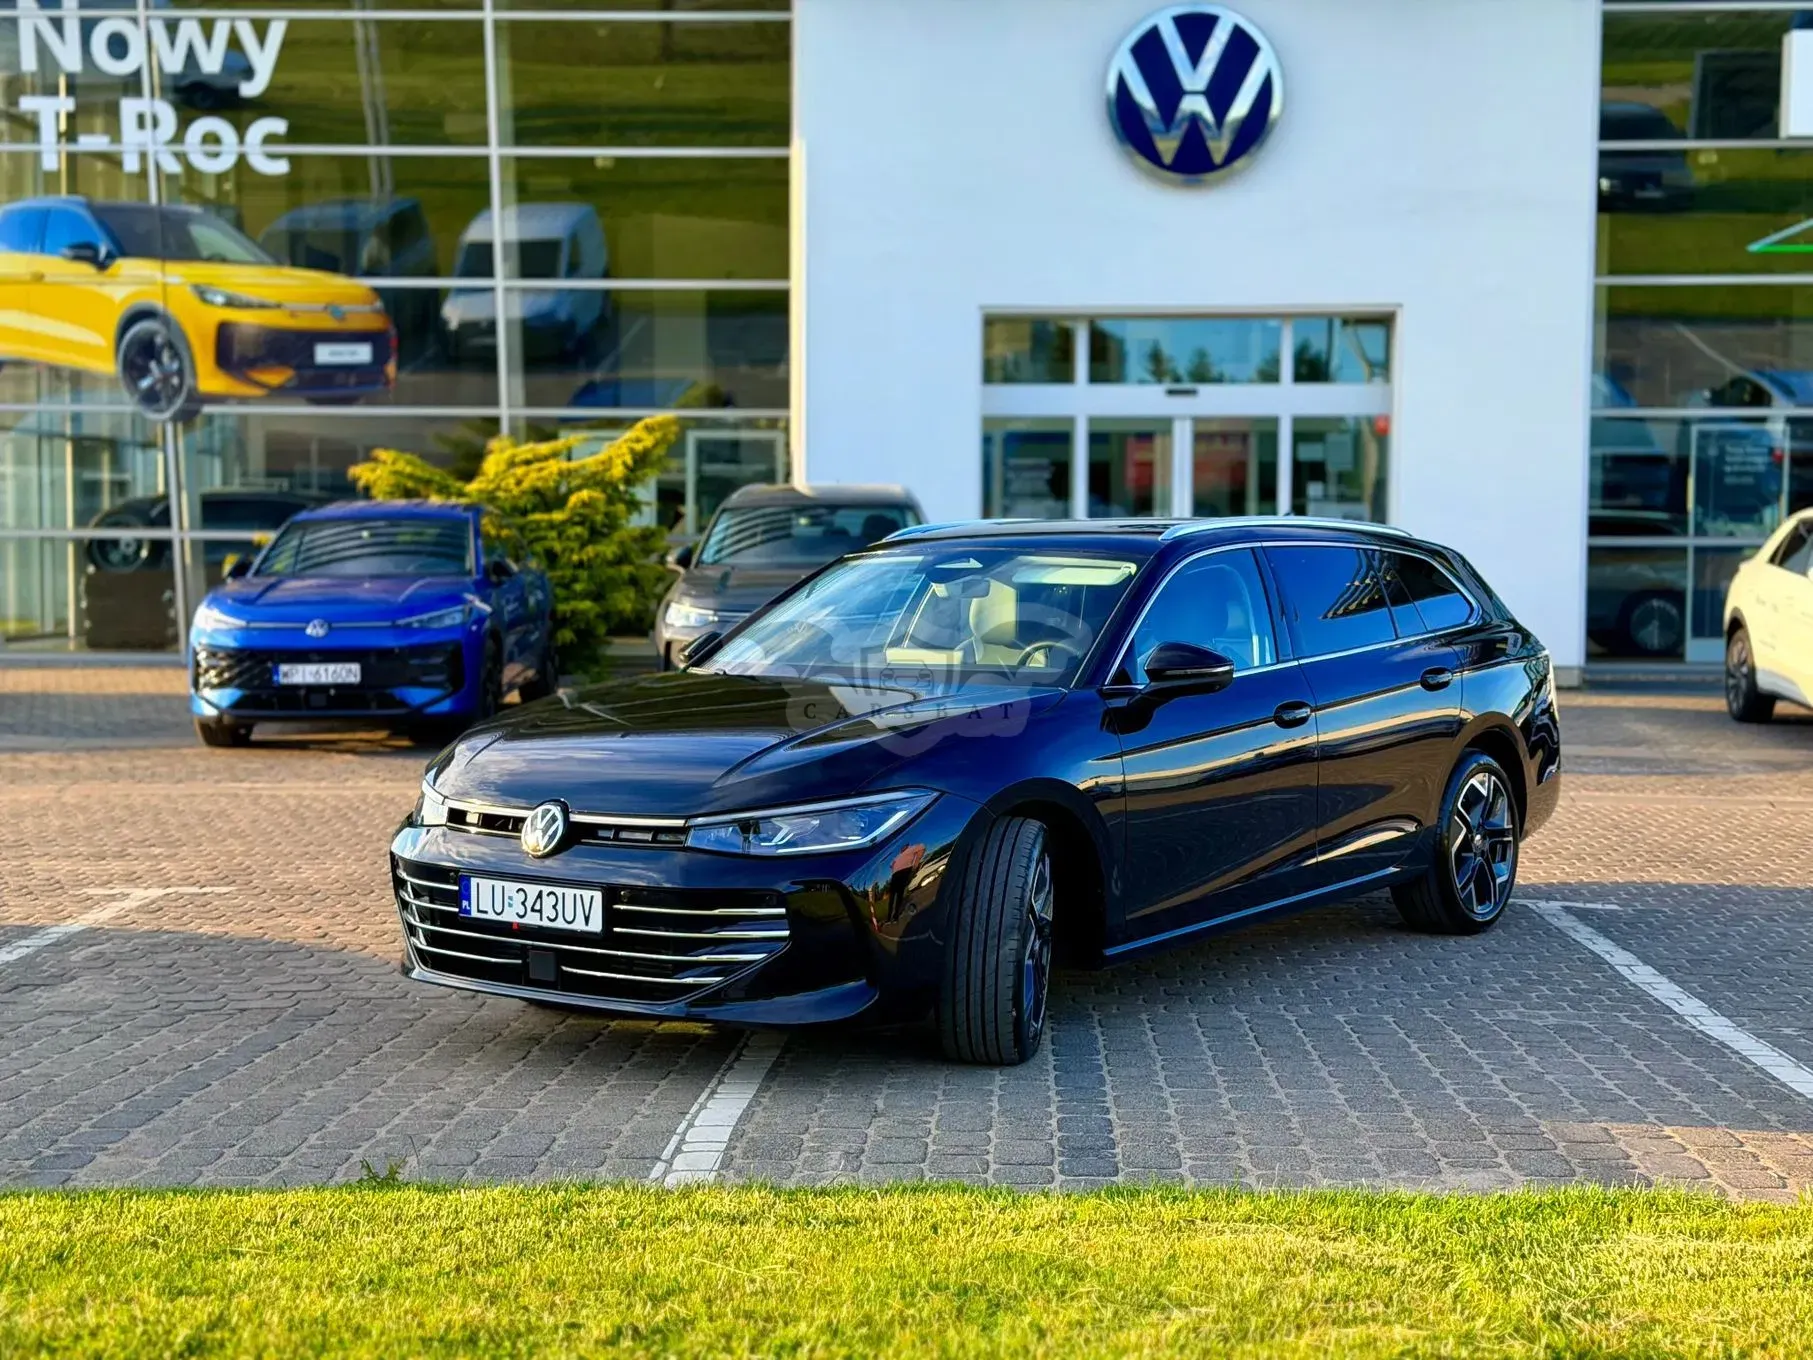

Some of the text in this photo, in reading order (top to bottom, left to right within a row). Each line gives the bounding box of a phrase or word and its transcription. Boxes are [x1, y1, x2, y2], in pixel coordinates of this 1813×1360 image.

[15, 0, 288, 98] Nowy
[18, 95, 291, 175] T-Roc
[461, 900, 471, 910] PL
